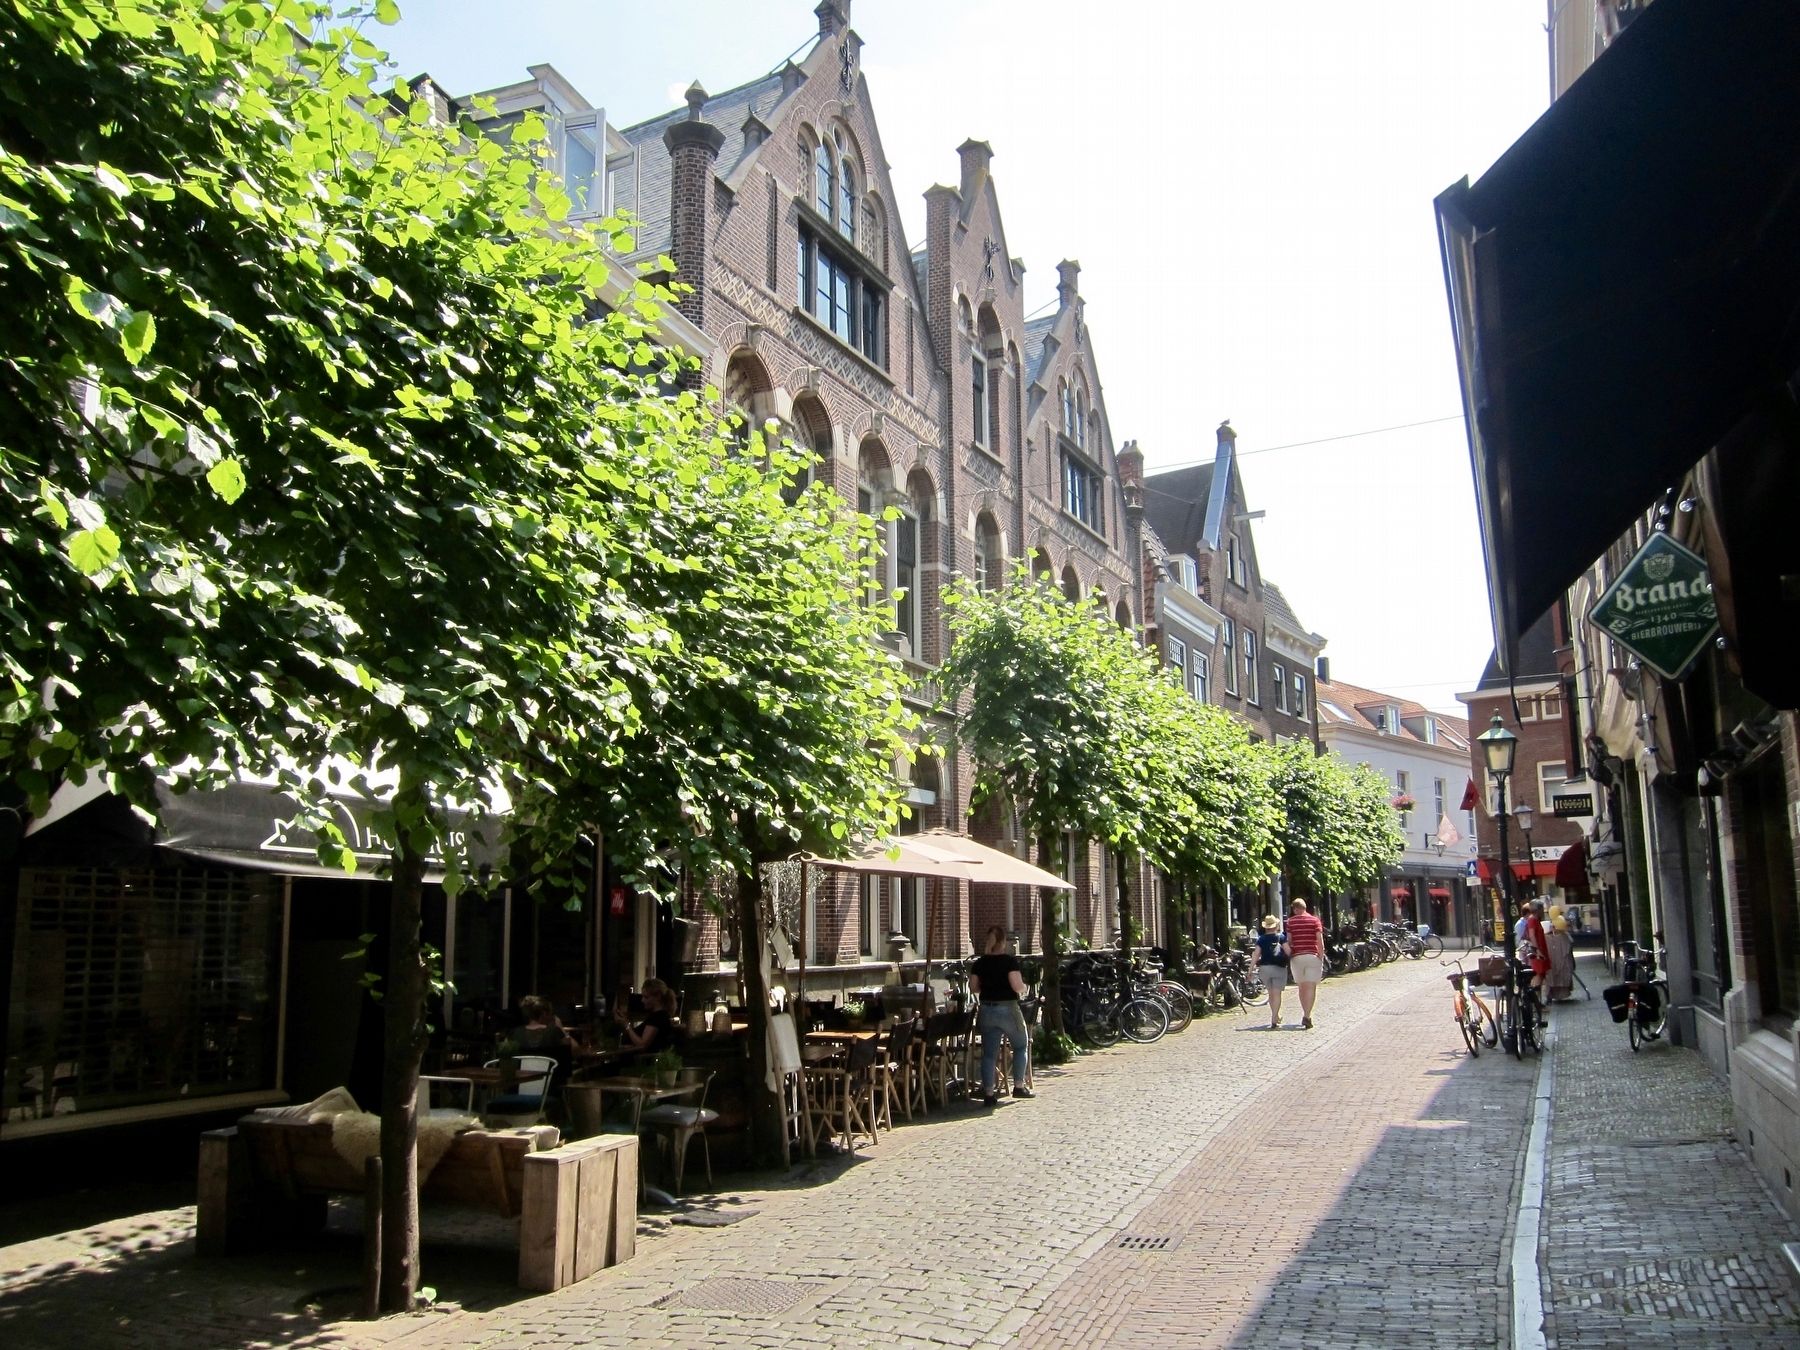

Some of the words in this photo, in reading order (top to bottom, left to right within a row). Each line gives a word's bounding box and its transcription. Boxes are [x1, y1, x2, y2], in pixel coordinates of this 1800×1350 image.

[1615, 571, 1712, 612] Brand
[1650, 612, 1677, 623] 1340
[1631, 622, 1701, 640] BIERBROUWERIJ
